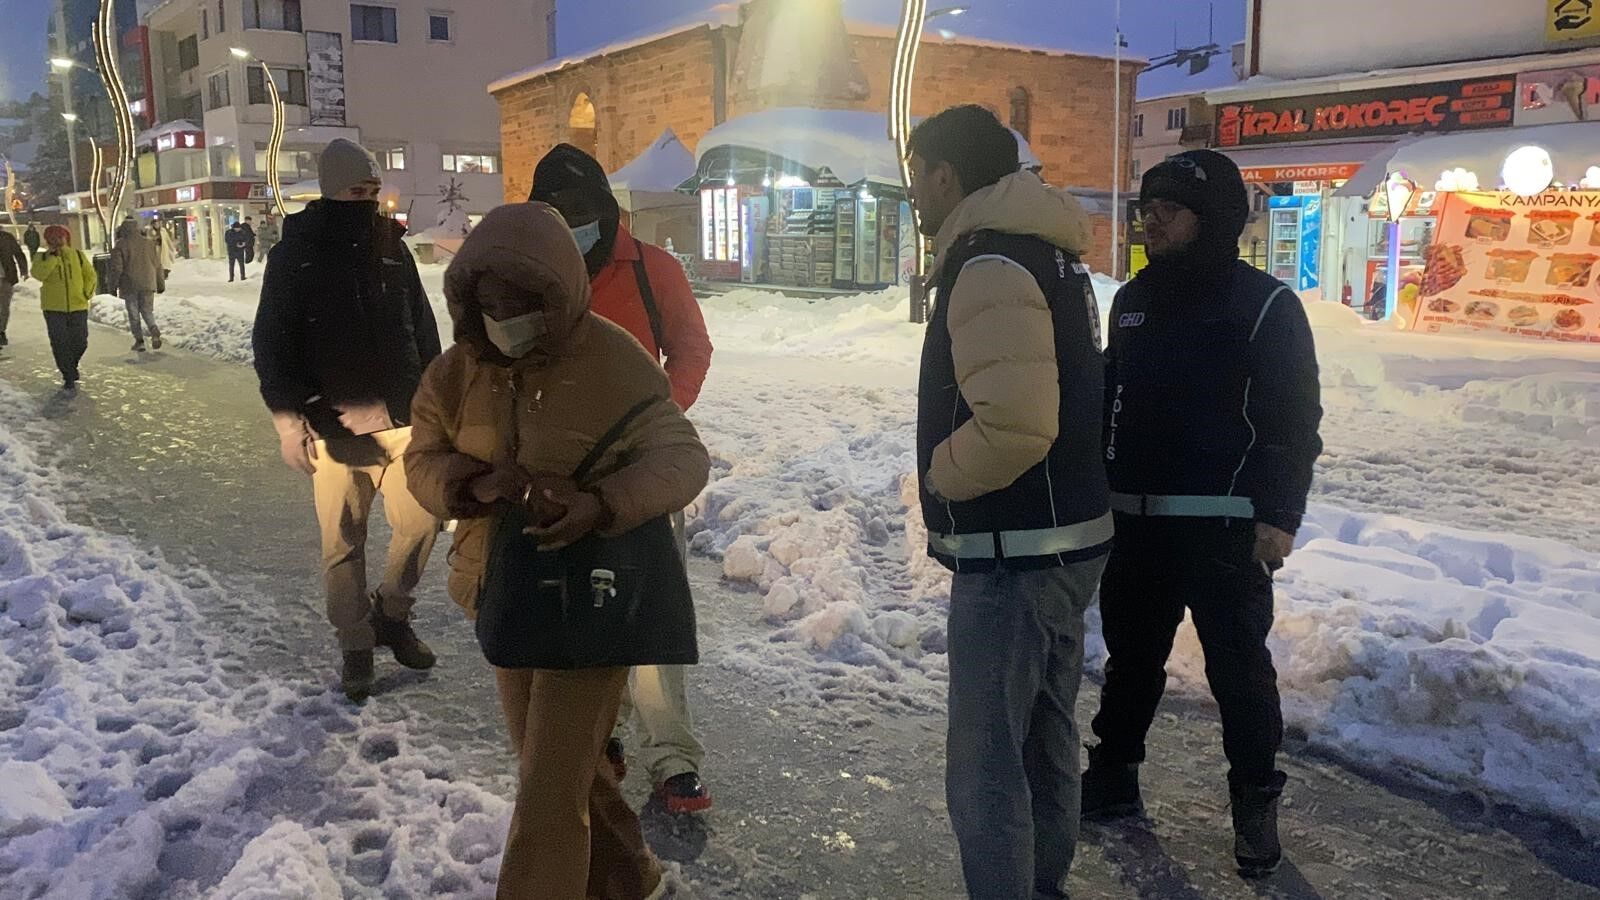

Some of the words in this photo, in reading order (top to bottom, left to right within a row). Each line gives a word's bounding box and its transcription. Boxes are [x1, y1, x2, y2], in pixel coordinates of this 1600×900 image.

[1242, 109, 1310, 136] KRAL
[1313, 95, 1449, 131] KOKOREÇ
[1119, 312, 1145, 328] GHD
